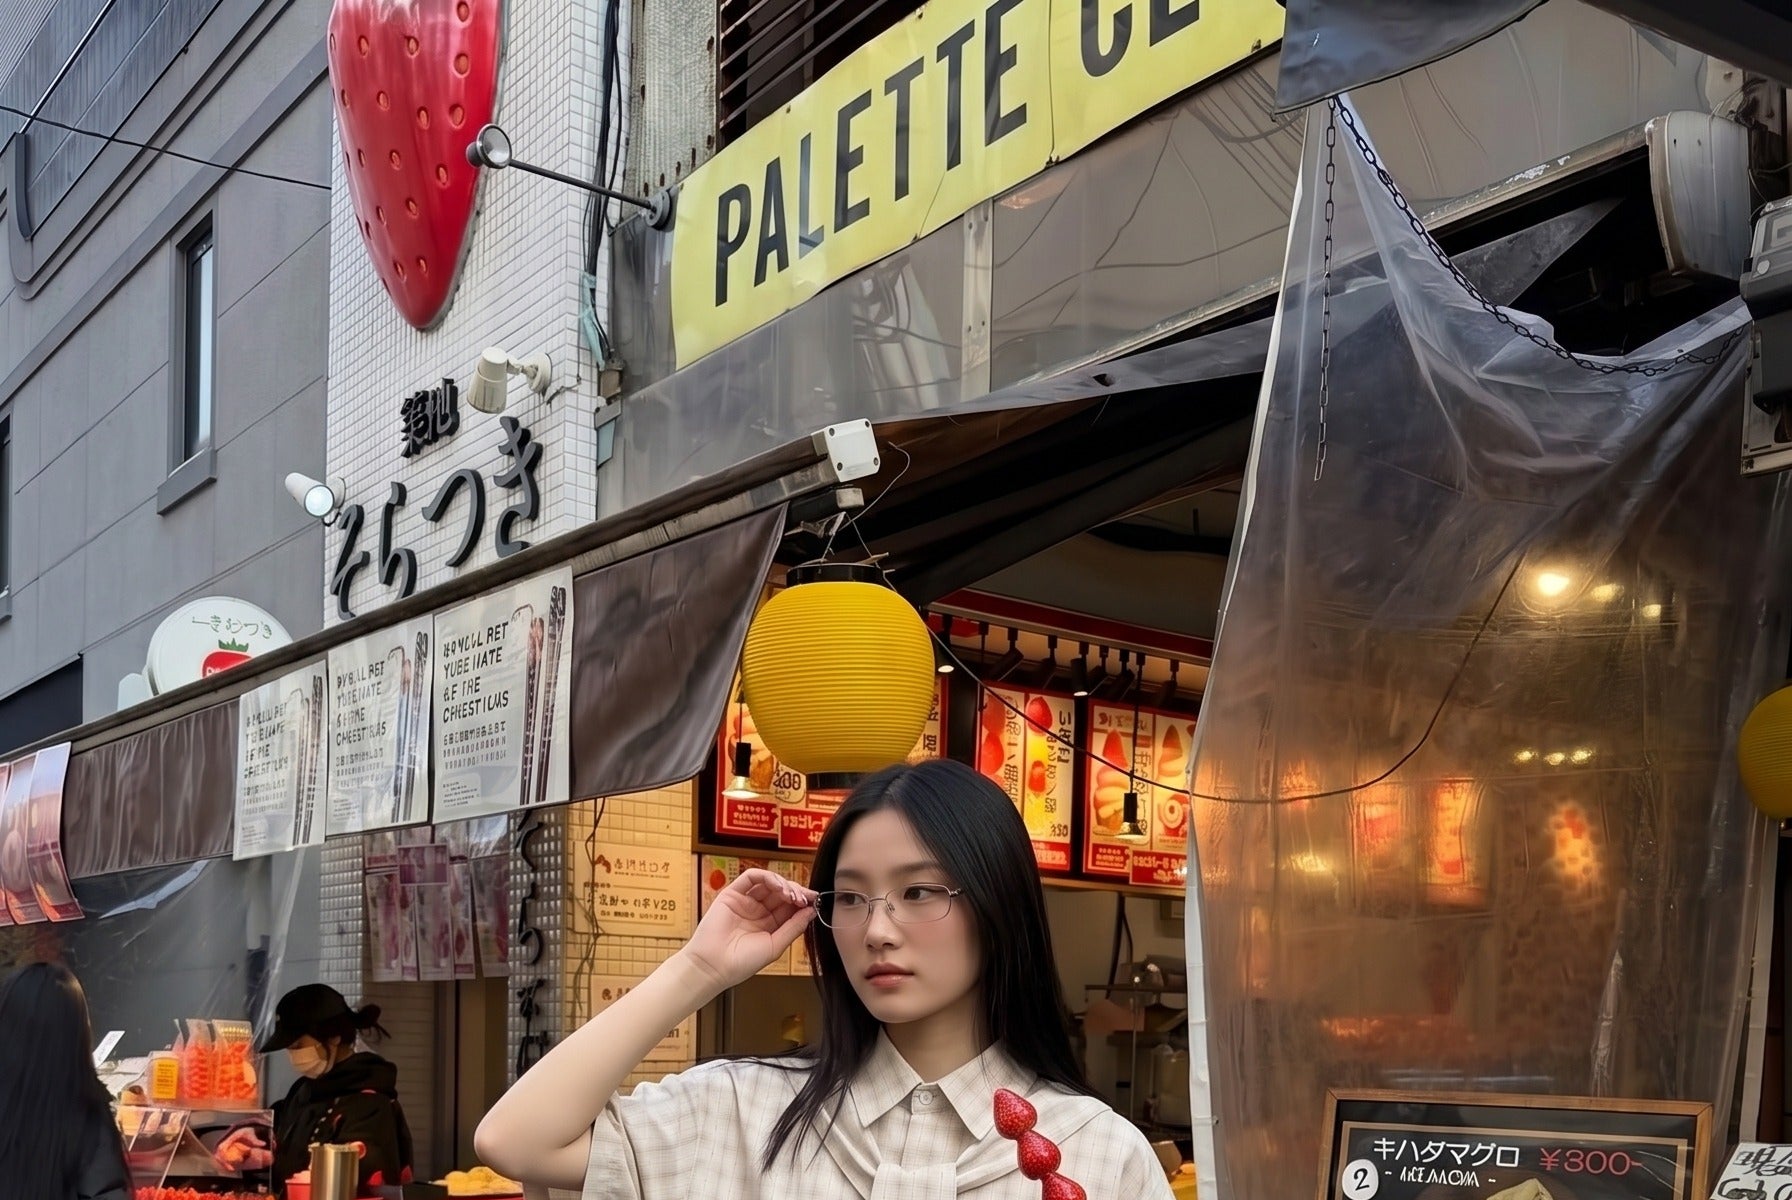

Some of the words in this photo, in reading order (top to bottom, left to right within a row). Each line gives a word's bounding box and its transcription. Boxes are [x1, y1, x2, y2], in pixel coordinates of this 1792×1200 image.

[714, 0, 1028, 307] PALETTE
[1373, 1137, 1520, 1168] キハダマグロ
[1353, 1167, 1370, 1191] 2
